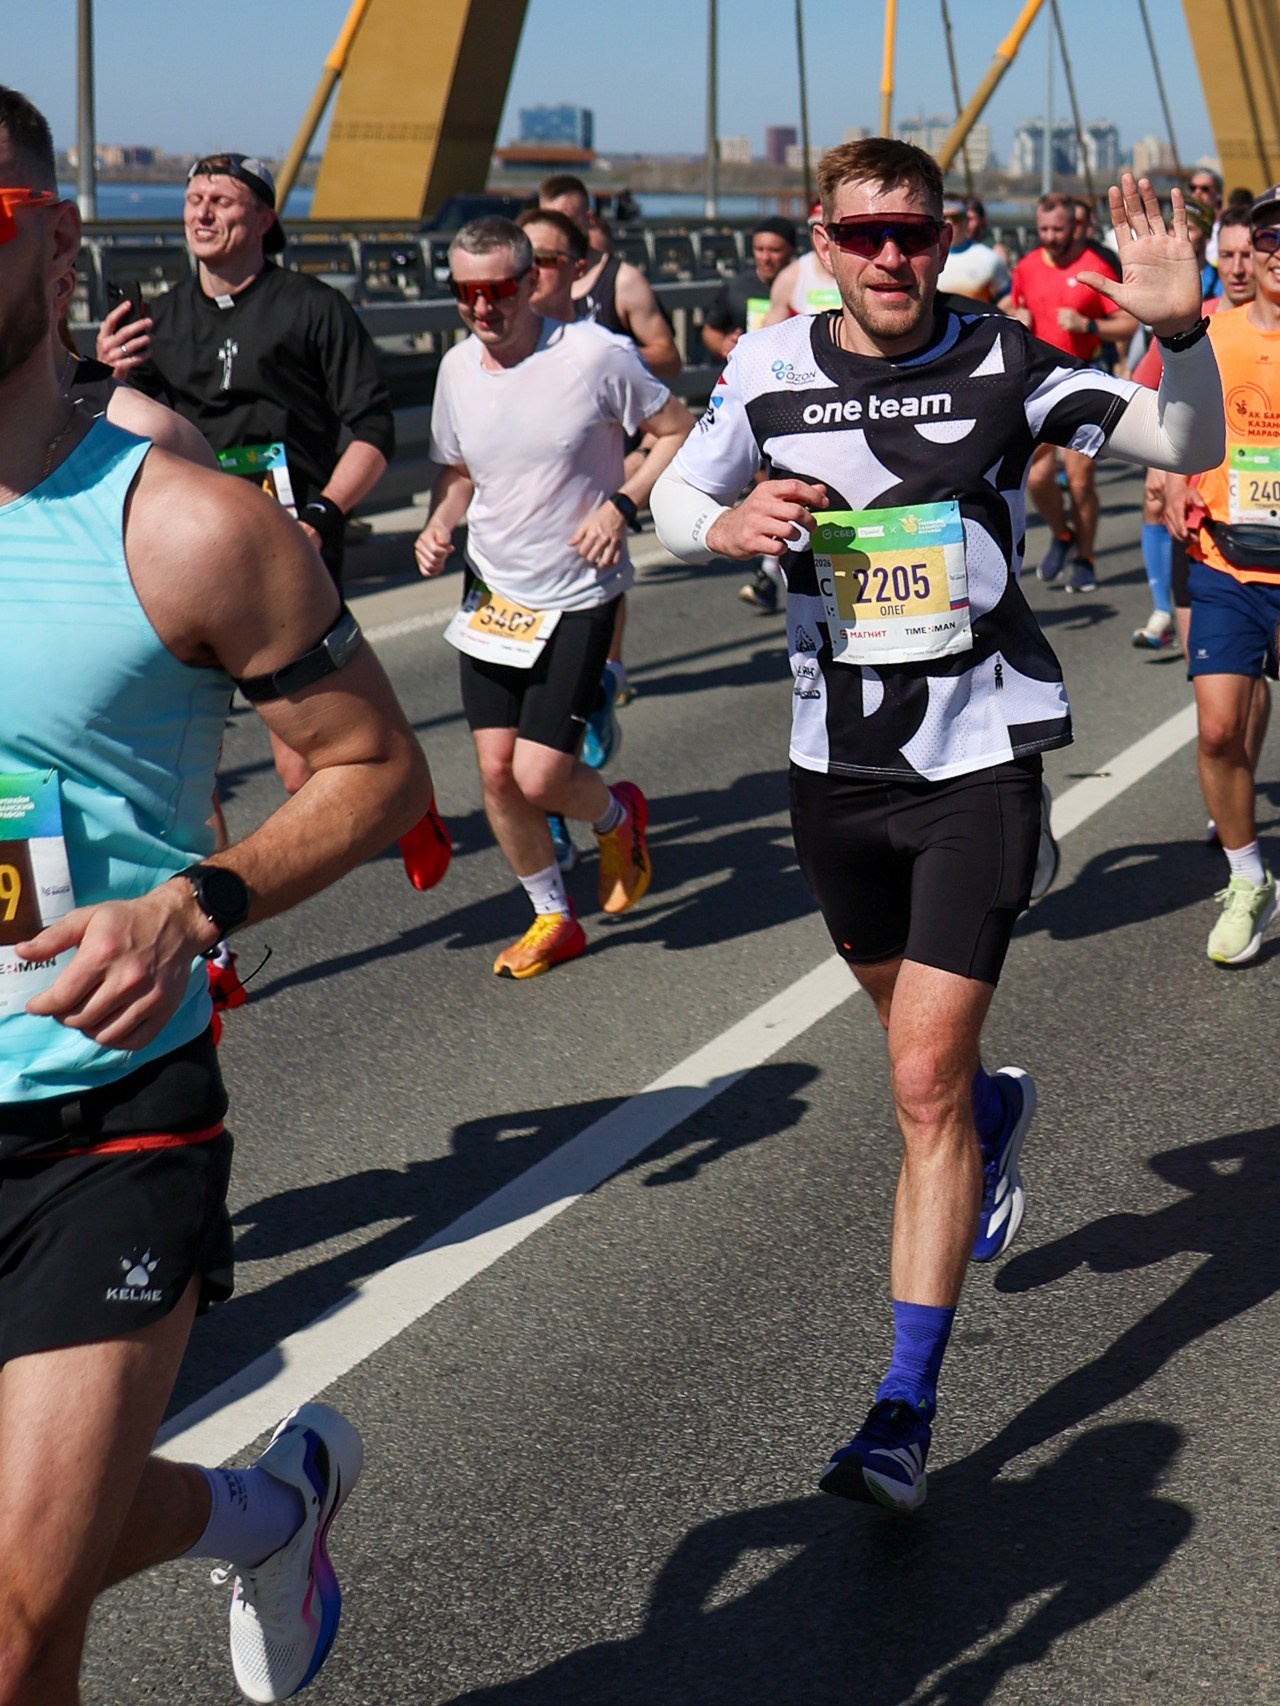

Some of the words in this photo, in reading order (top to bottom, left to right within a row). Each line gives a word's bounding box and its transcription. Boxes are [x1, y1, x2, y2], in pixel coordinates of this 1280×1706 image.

[786, 371, 816, 381] OZON
[803, 400, 863, 425] one
[868, 393, 952, 419] team
[853, 563, 931, 604] 2205
[880, 604, 906, 616] ОЛЕГ
[850, 630, 887, 639] МАГНИТ
[106, 1288, 162, 1301] KELME
